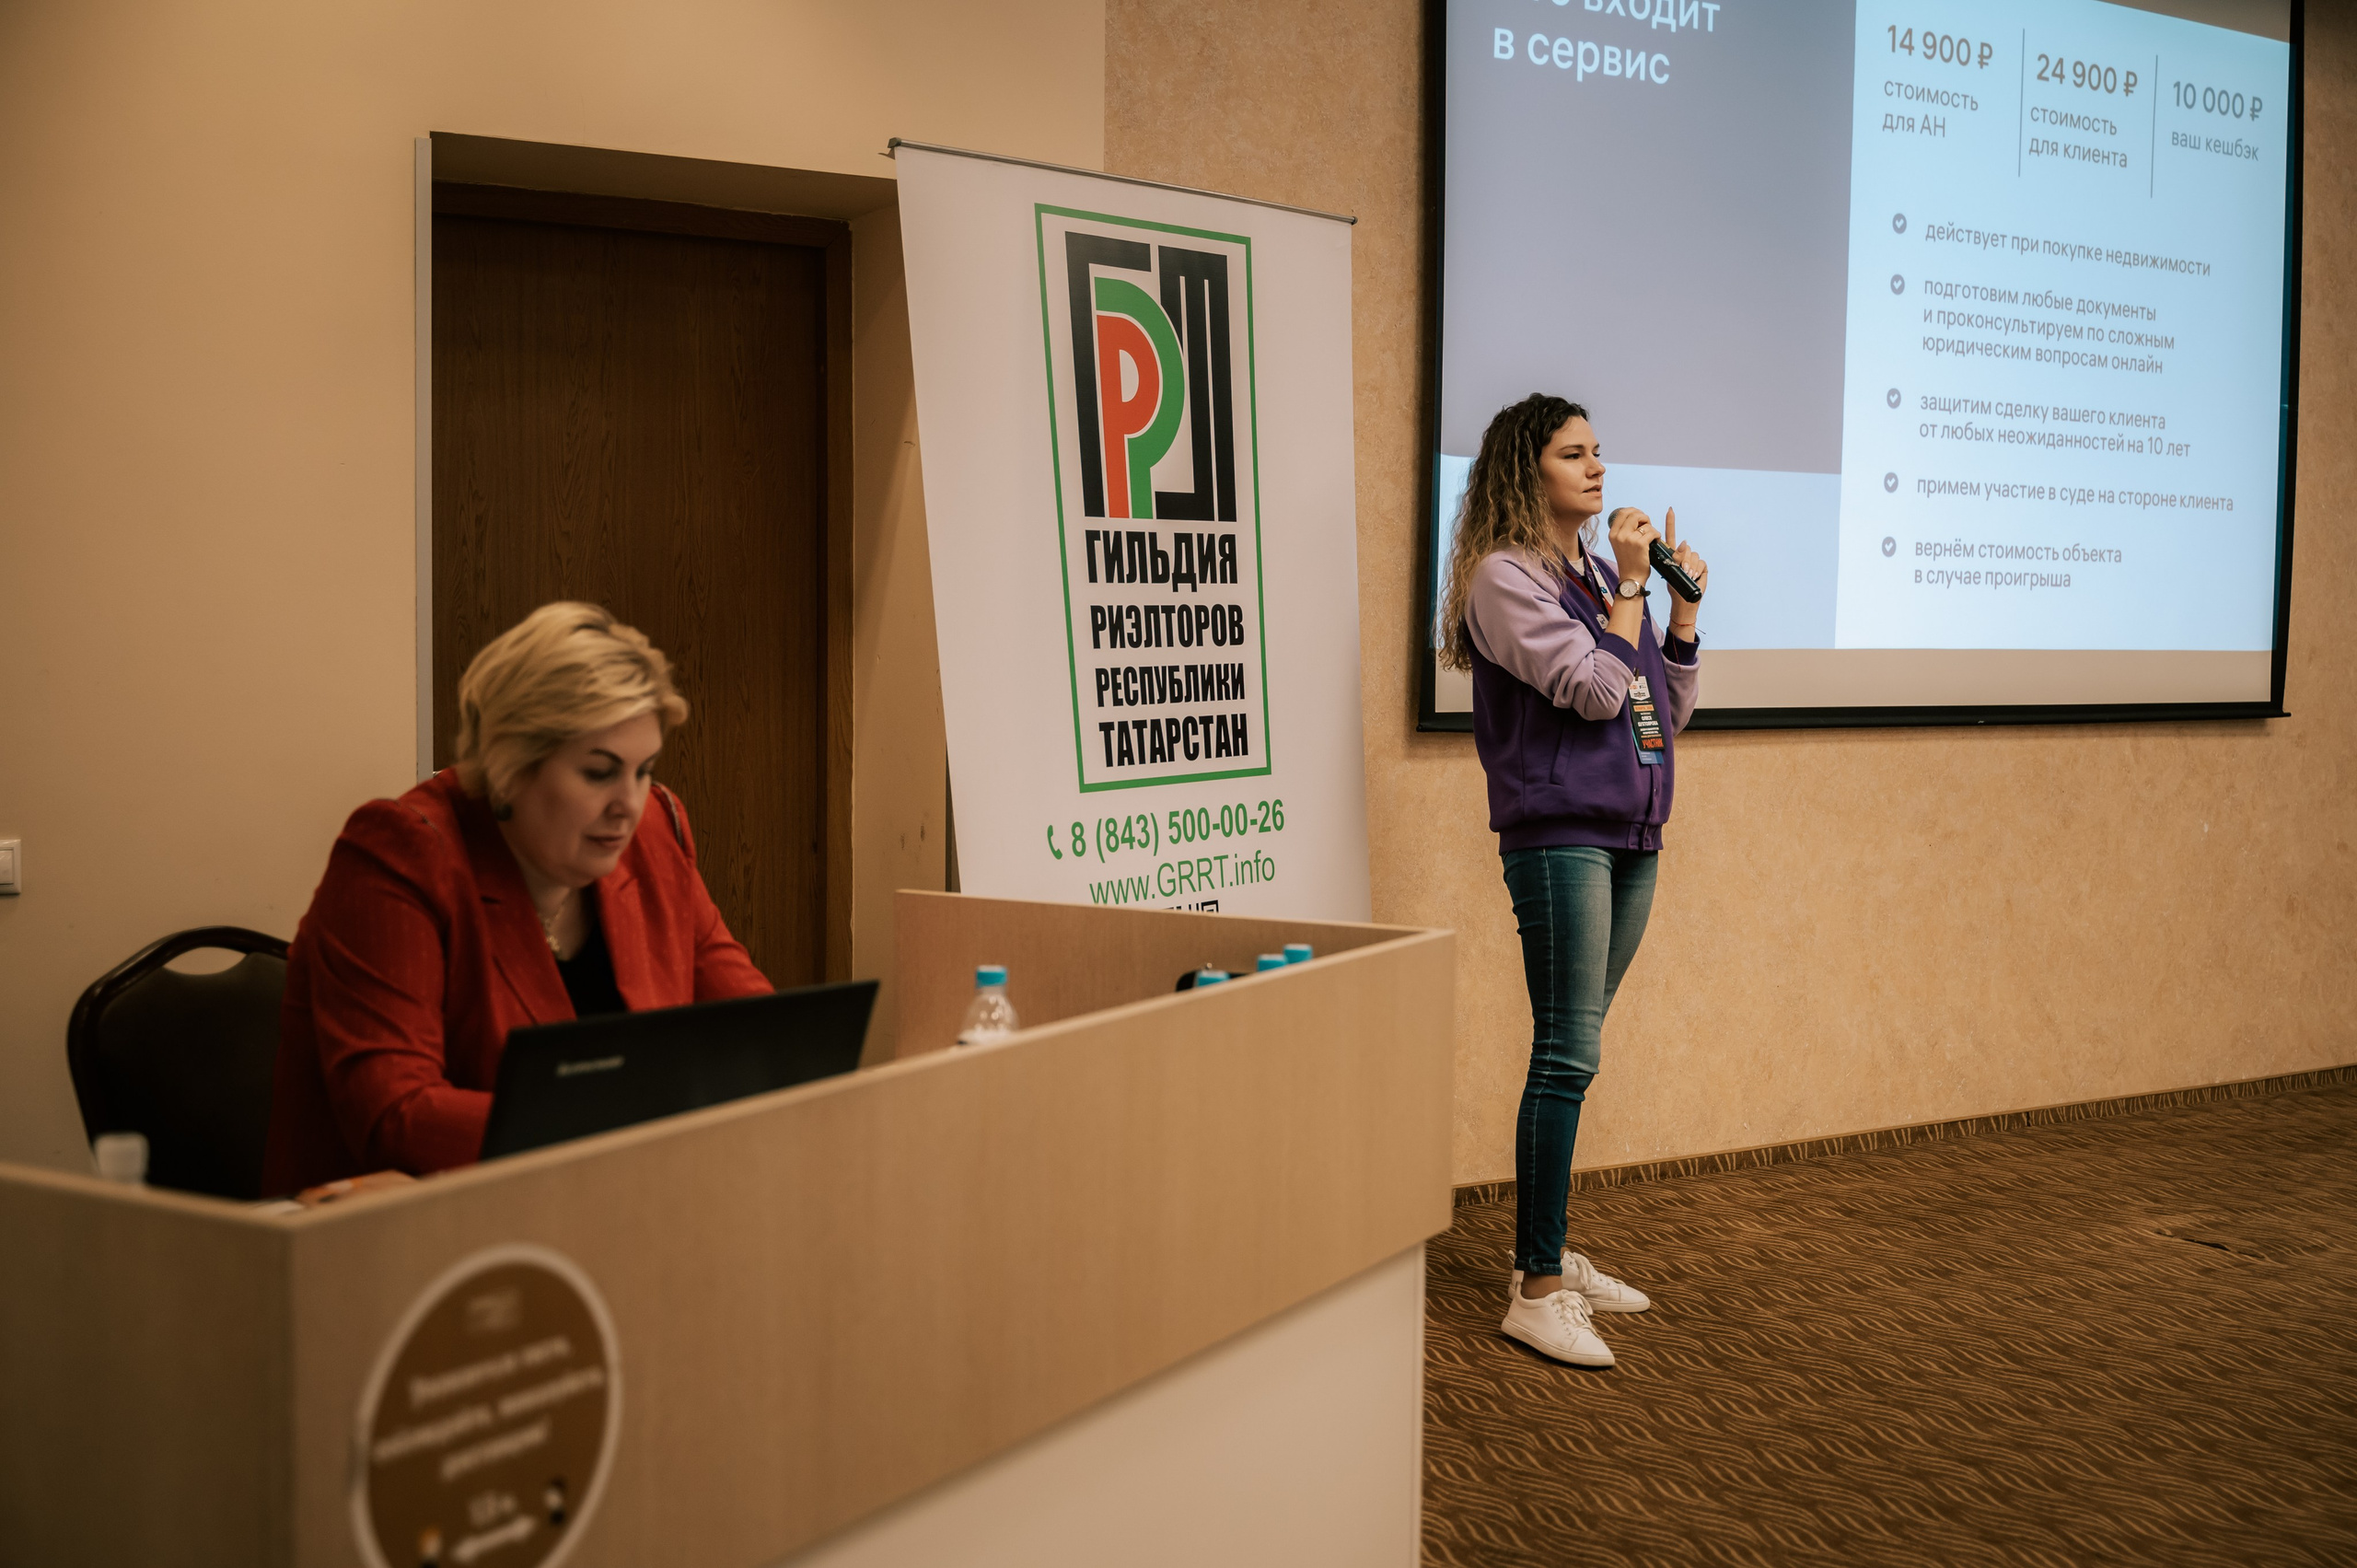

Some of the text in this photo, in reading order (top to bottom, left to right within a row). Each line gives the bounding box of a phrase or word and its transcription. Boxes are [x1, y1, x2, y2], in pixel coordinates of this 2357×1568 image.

[1493, 28, 1670, 85] в сервис
[1887, 25, 1914, 56] 14
[1922, 31, 1971, 66] 900
[2037, 53, 2065, 85] 24
[2073, 61, 2117, 94] 900
[1884, 81, 1979, 110] стоимость
[2173, 81, 2197, 110] 10
[2202, 87, 2245, 119] 000
[1883, 113, 1945, 138] для АН
[2030, 107, 2117, 135] стоимость
[2029, 138, 2128, 168] для клиента
[2172, 131, 2259, 161] ваш кешбэк
[1925, 221, 2211, 276] действует при покупке недвижимости
[1924, 279, 2156, 321] подготовим любые документы
[1923, 308, 2175, 350] и проконсультируем по сложным
[1922, 335, 2163, 375] юридическим вопросам онлайн
[1920, 394, 2165, 430] защитим сделку вашего клиента
[1919, 422, 2191, 458] от любых неожиданностей на 10 лет
[1916, 477, 2234, 512] примем участие в суде на стороне клиента
[1085, 529, 1238, 593] ГИЛЬДИЯ
[1914, 539, 2122, 563] вернём стоимость объекта
[1914, 567, 2072, 590] в случае проигрыша
[1090, 603, 1245, 649] РИЭЛТОРОВ
[1095, 663, 1246, 708] РЕСПУБЛИКИ
[1098, 713, 1249, 768] ТАТАРСТАН
[1071, 798, 1284, 864] 8 (843) 500-00-26
[1089, 849, 1275, 905] www.GRRT.info
